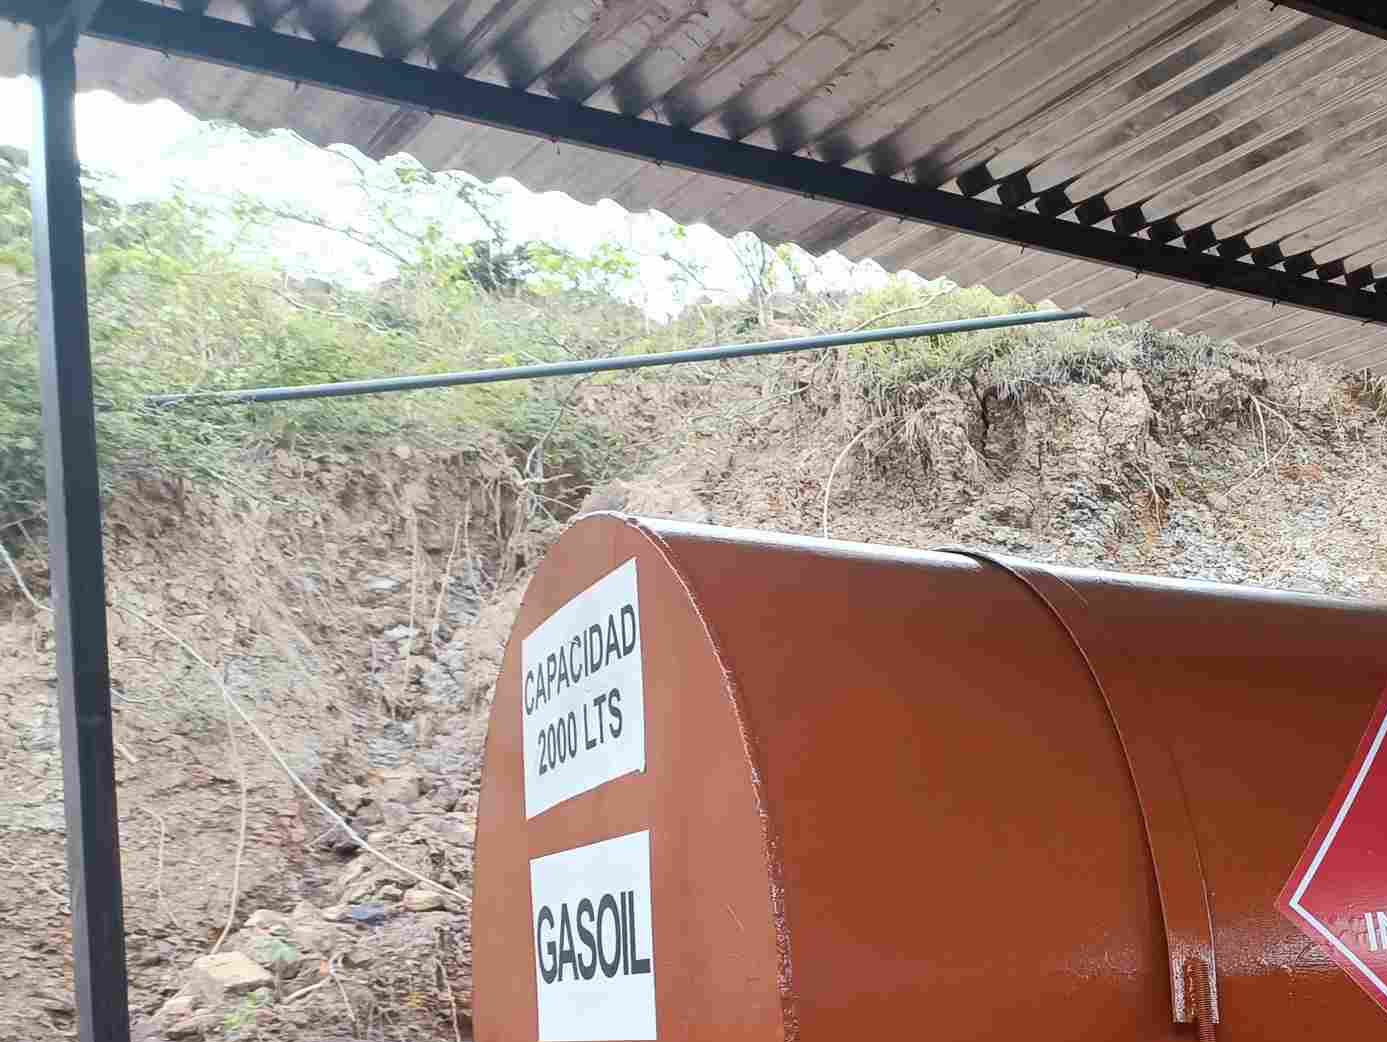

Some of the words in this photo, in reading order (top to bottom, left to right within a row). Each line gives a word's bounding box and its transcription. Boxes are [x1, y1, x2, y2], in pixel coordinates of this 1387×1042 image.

[524, 604, 637, 716] CAPACIDAD
[538, 709, 578, 776] 2000
[583, 688, 624, 751] LTS
[536, 891, 652, 985] GASOIL
